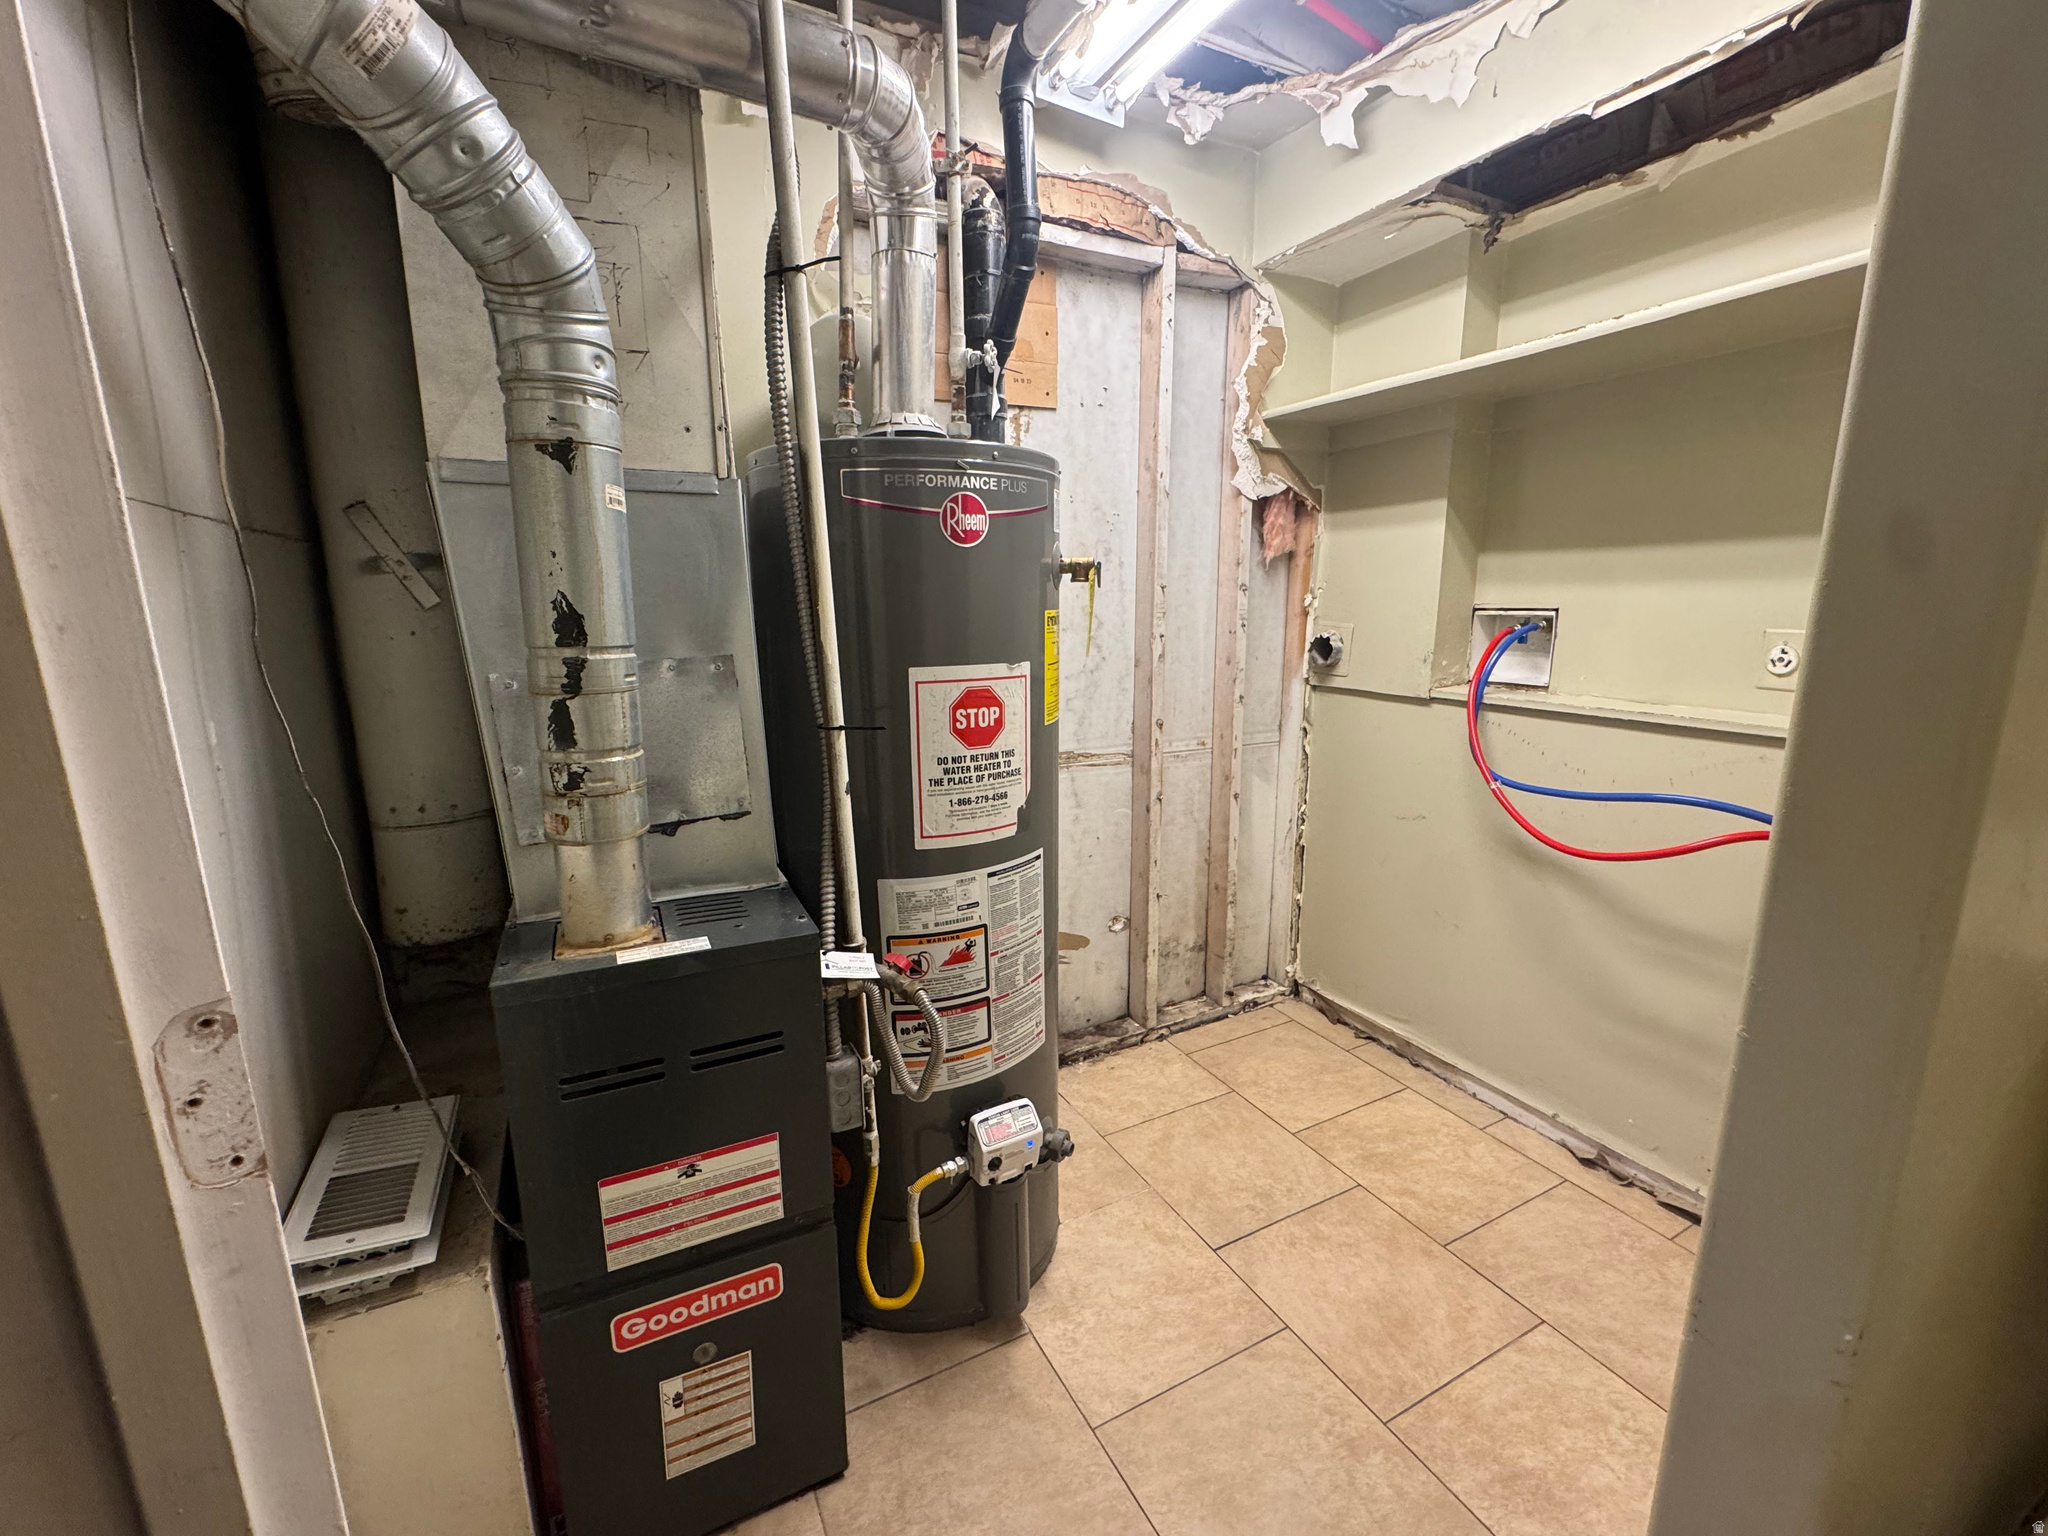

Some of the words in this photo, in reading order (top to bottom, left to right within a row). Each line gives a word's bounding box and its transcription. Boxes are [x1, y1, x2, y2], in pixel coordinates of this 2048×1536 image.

[884, 473, 998, 491] PERFORMANCE
[1001, 479, 1027, 494] PLUS
[947, 493, 986, 538] Rheem
[955, 706, 1000, 730] STOP
[937, 756, 949, 766] DO
[951, 755, 968, 765] NOT
[970, 751, 999, 764] RETURN
[1001, 749, 1015, 759] THIS
[942, 765, 972, 776] WATER
[973, 761, 1001, 773] HEATER
[1003, 759, 1012, 769] TO
[928, 777, 945, 788] THE
[947, 775, 973, 786] PLACE
[975, 773, 986, 783] OF
[987, 767, 1022, 782] PURCHASE
[949, 791, 1008, 808] 1-866-279-4566
[926, 934, 960, 944] WARNING
[620, 1276, 775, 1340] Goodman
